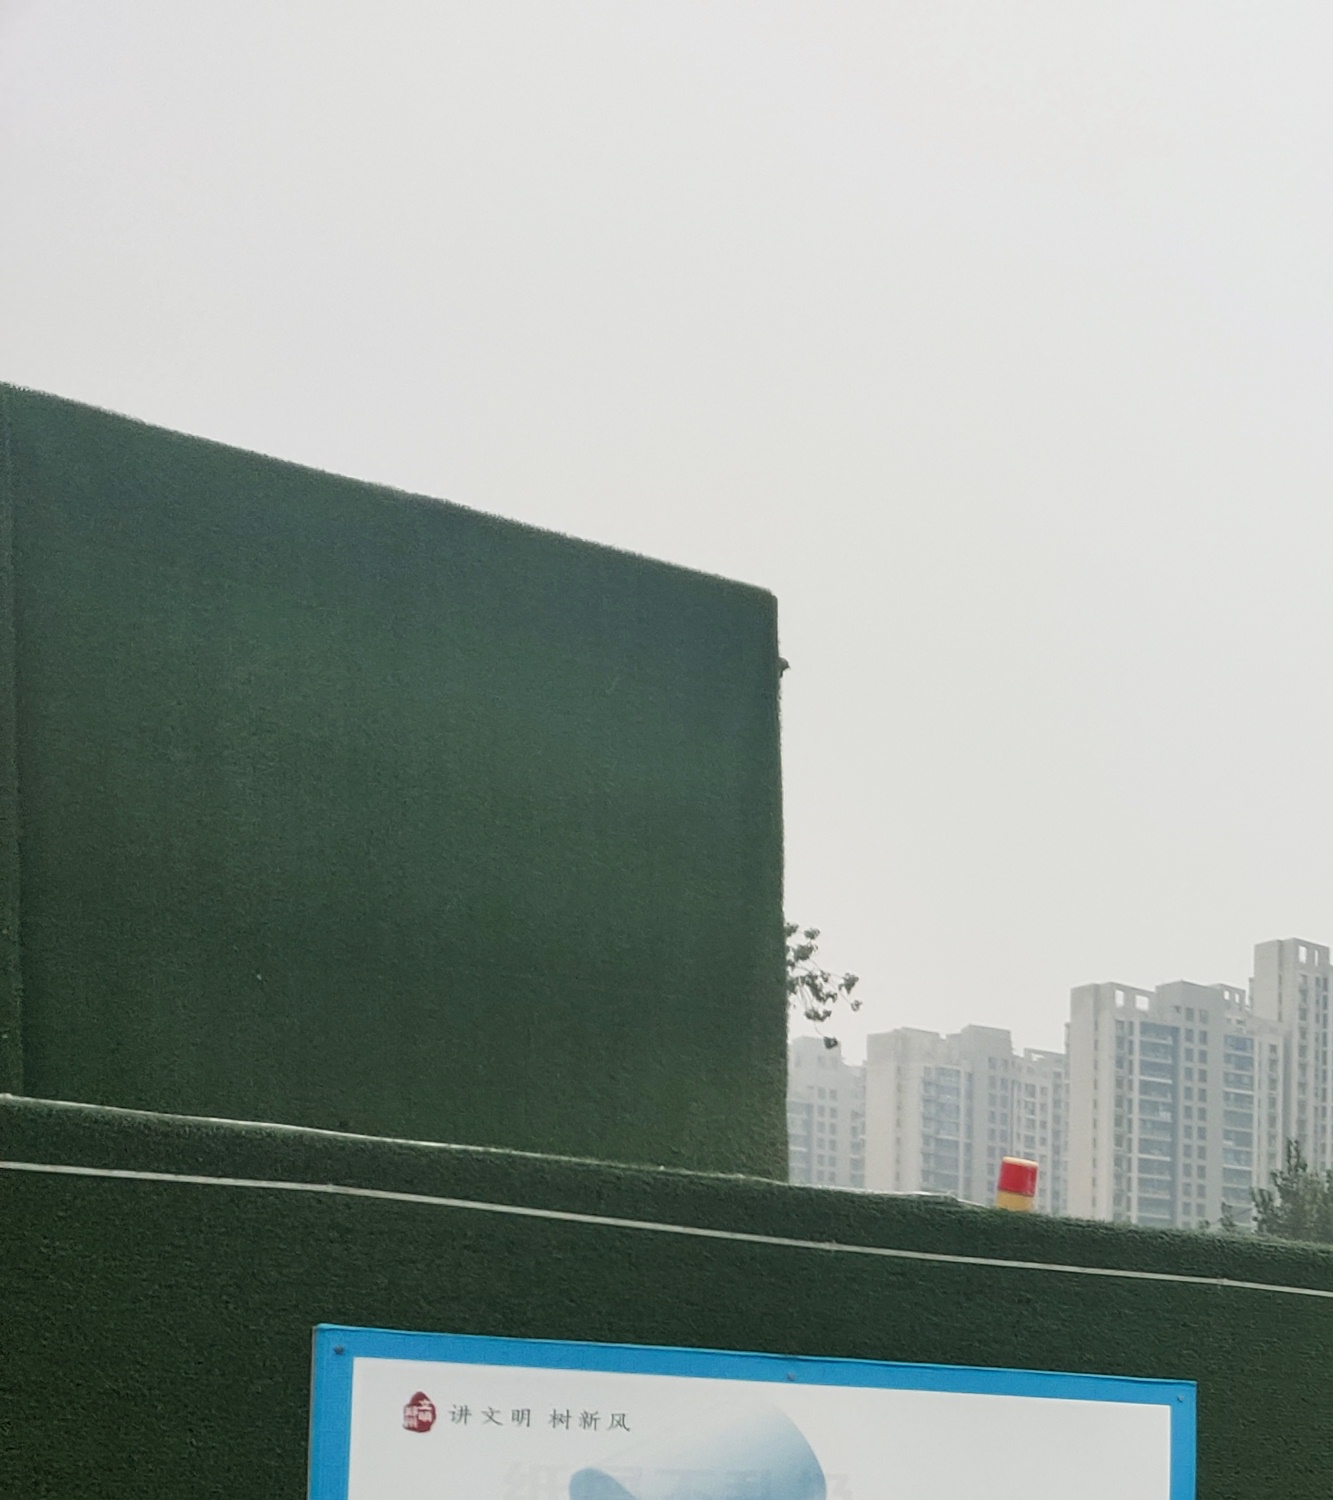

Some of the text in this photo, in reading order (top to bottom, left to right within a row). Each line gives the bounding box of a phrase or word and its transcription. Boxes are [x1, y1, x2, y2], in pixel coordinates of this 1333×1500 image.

[449, 1404, 631, 1431] 讲文明 树新风
